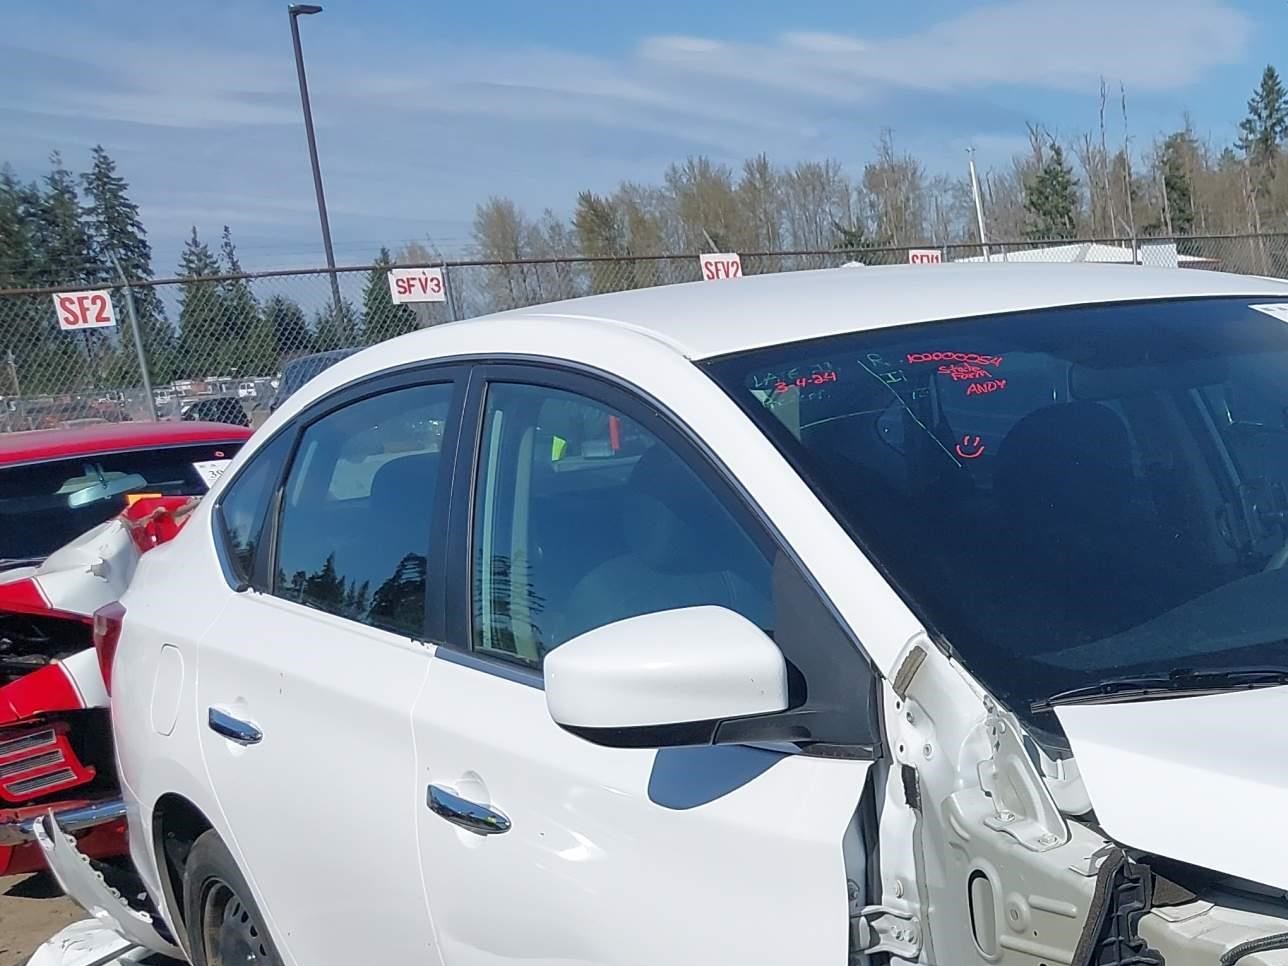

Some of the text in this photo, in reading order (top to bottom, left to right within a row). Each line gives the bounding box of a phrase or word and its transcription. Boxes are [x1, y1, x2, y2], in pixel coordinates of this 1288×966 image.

[704, 261, 740, 280] SFV2
[395, 277, 442, 295] SFV3
[60, 294, 111, 326] SF2
[966, 379, 1007, 396] ANDY
